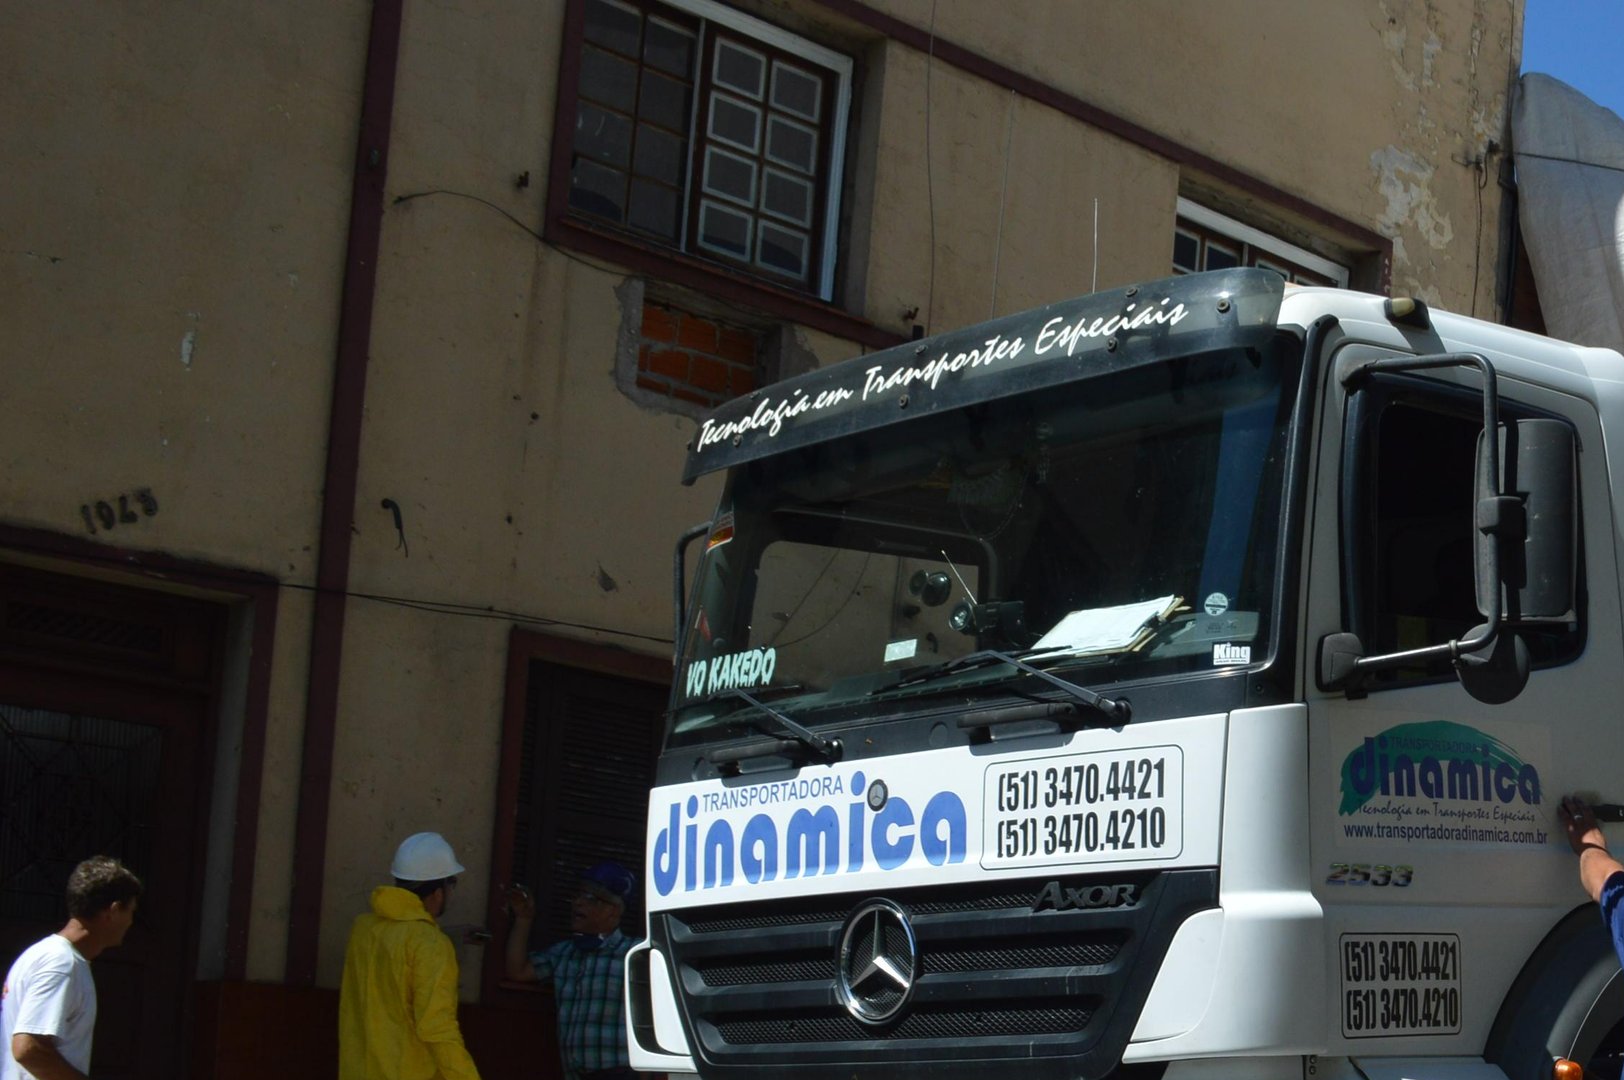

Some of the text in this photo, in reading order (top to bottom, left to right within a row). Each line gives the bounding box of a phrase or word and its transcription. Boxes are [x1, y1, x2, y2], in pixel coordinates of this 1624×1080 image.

[696, 297, 1188, 452] Tecnologia em Transportes Especiais
[707, 648, 776, 695] KAKEDO
[1213, 642, 1251, 664] King
[1390, 736, 1477, 754] TRANSPORTADORA
[998, 757, 1165, 812] (51) 3470.4421
[1351, 736, 1542, 805] dinamica
[702, 780, 845, 813] TRANSPORTADORA
[1358, 800, 1536, 823] Tecnologia em Transportes Especiais
[653, 770, 967, 897] dinamica
[997, 806, 1166, 859] (51) 3470.4210
[1344, 822, 1548, 844] www.transportadoradinamica.com.br
[1326, 863, 1414, 886] 2533
[1345, 940, 1458, 982] (51) 3470.4421
[1346, 988, 1458, 1031] (51) 3470.4210
